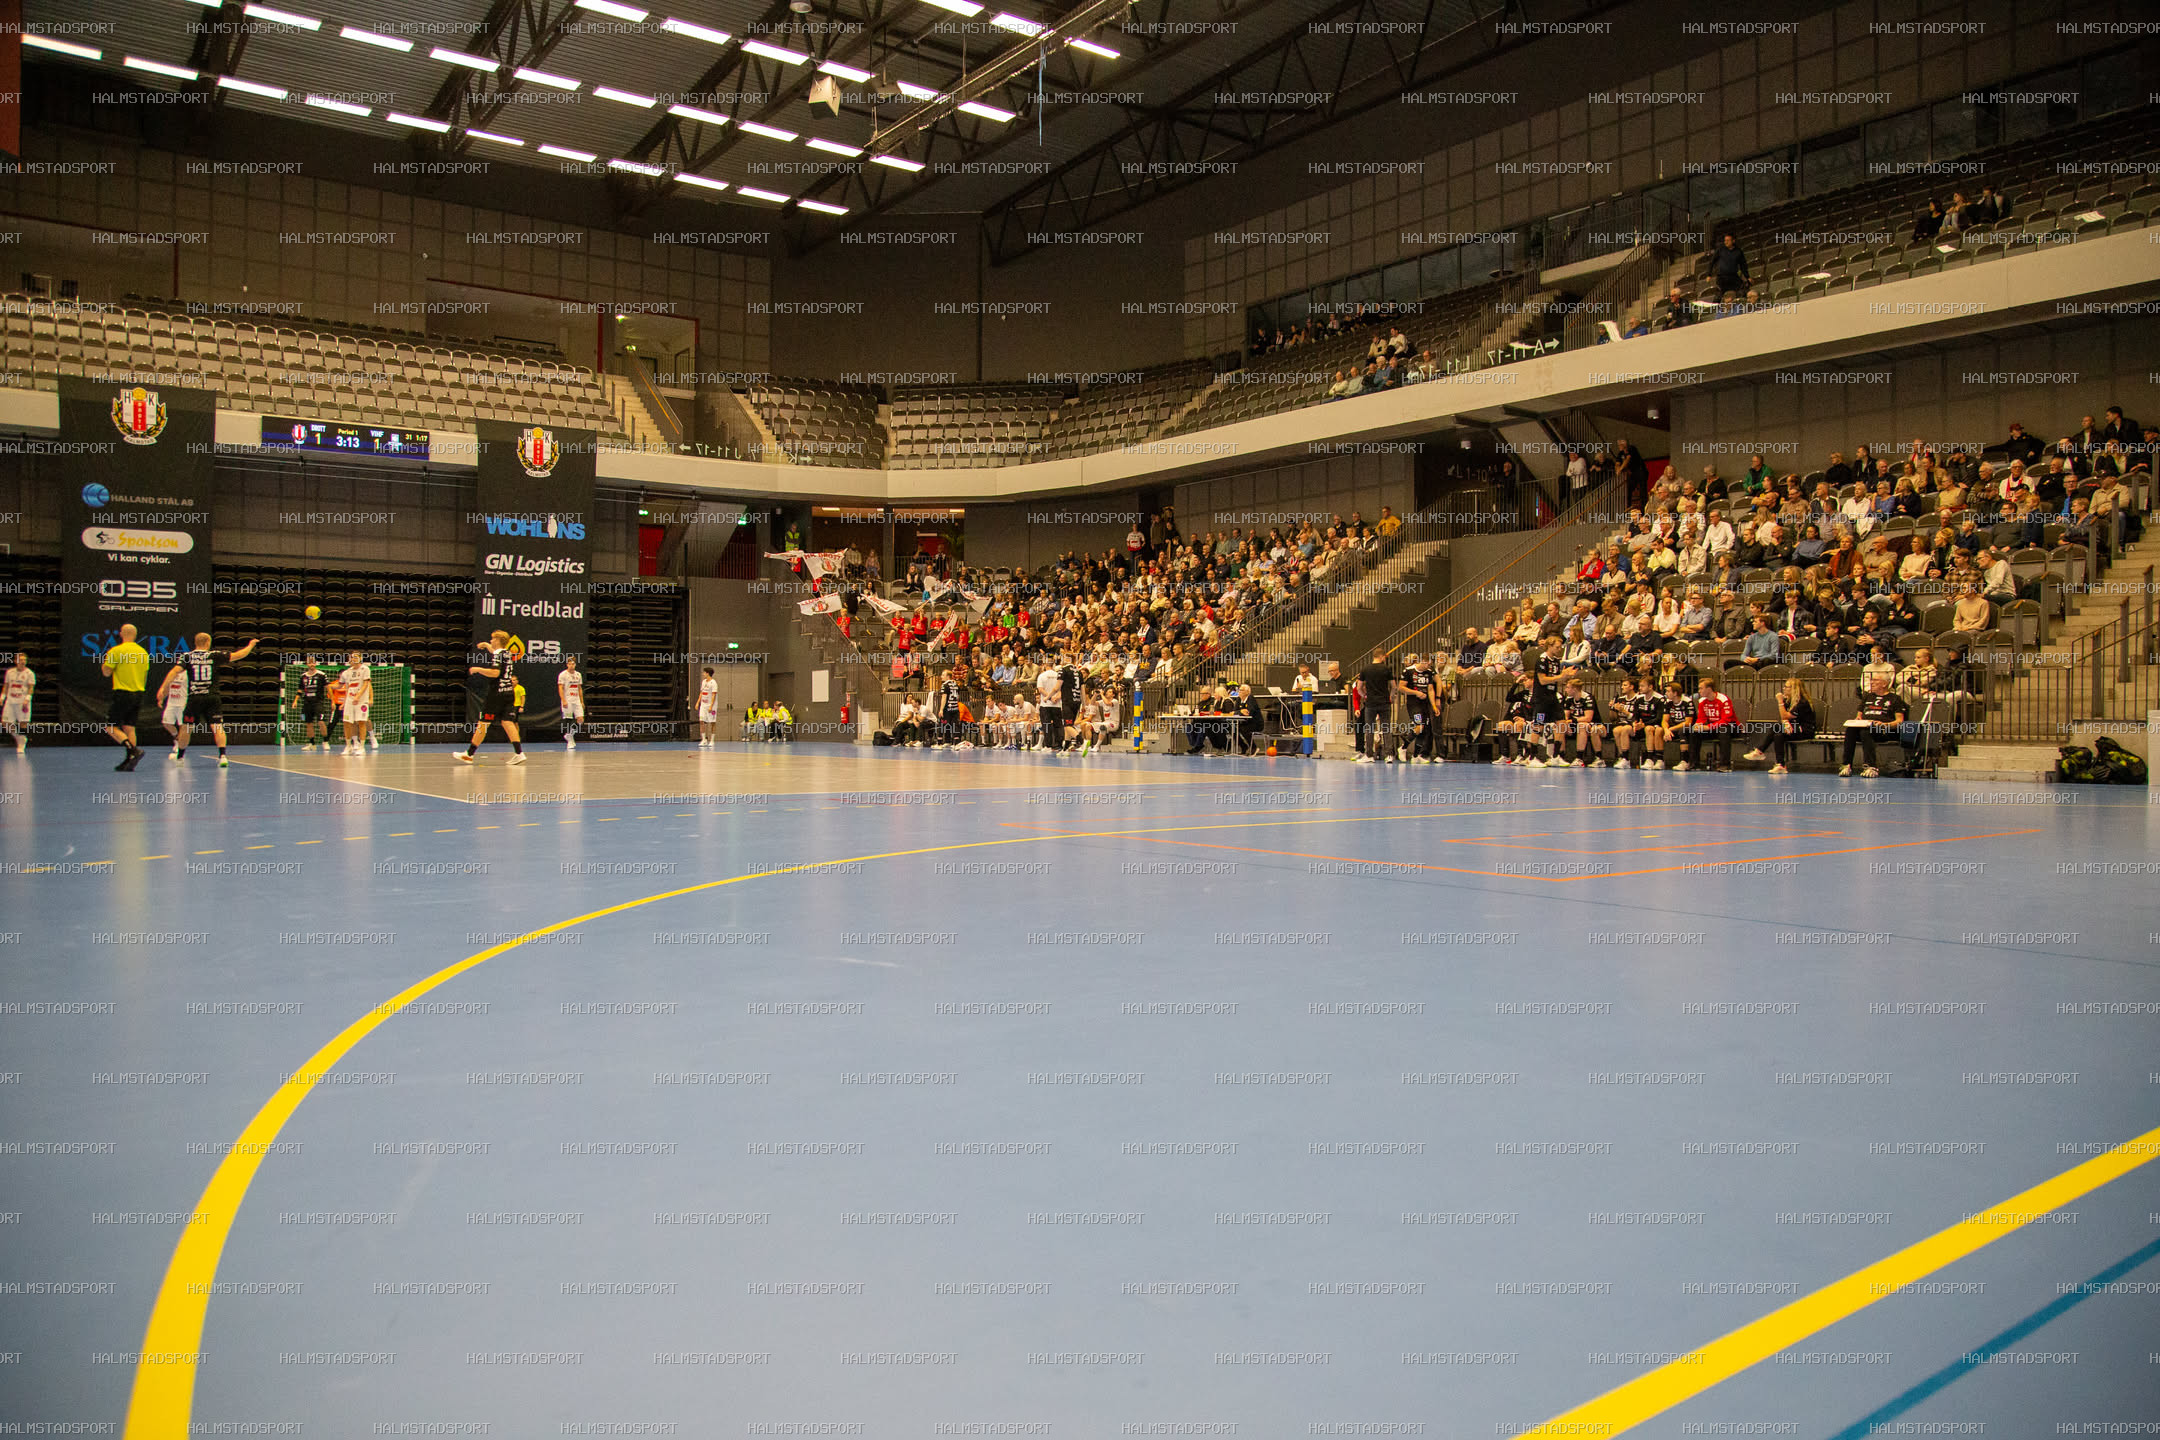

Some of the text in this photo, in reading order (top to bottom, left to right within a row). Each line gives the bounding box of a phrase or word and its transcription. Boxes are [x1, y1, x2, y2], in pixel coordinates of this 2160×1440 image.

[338, 428, 354, 436] Period
[315, 433, 322, 444] 1
[336, 436, 360, 448] 3:13
[374, 438, 380, 450] 1
[111, 494, 155, 505] HALLAND
[108, 553, 171, 565] Vi kan cyklar.
[486, 554, 585, 576] GN Logistics
[99, 605, 179, 613] GRUPPEN
[500, 598, 584, 619] Fredblad
[82, 630, 190, 657] SÄRA
[528, 640, 561, 654] PS
[192, 664, 213, 682] 10
